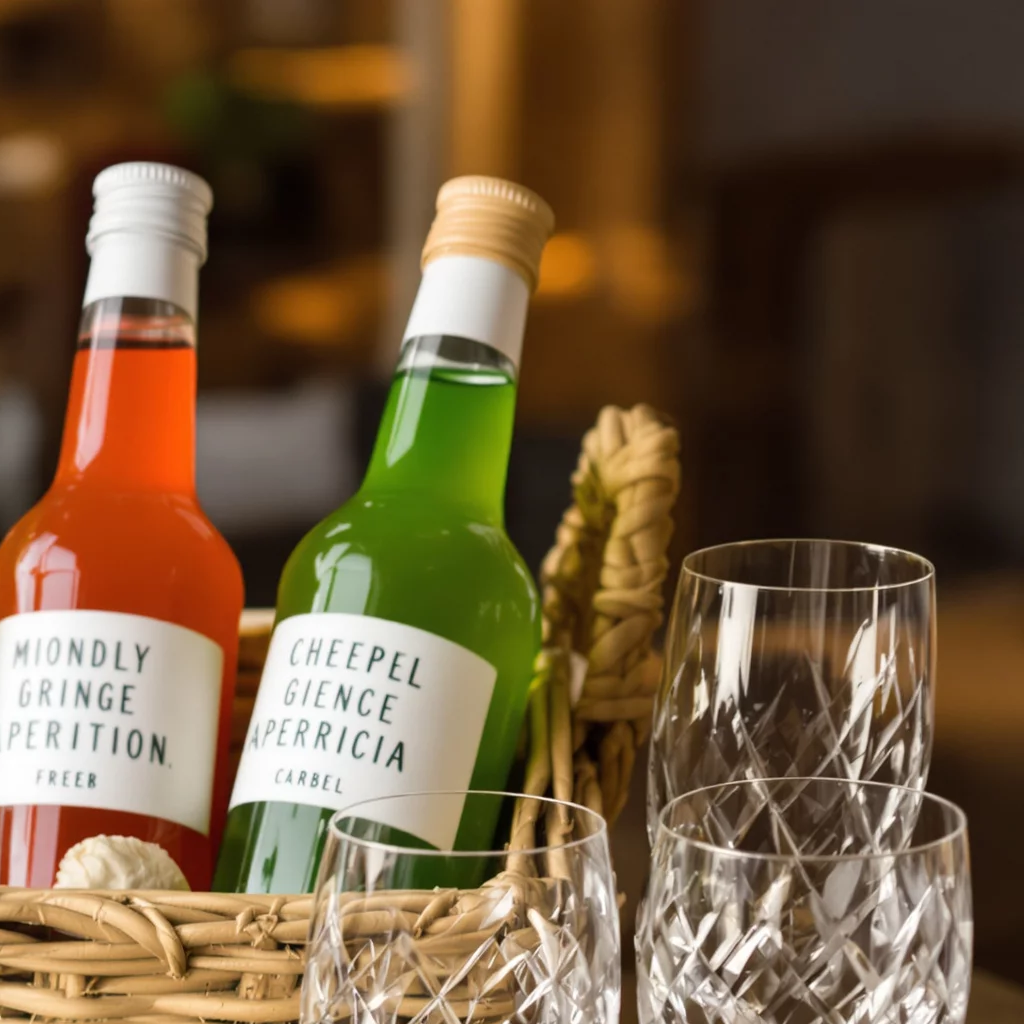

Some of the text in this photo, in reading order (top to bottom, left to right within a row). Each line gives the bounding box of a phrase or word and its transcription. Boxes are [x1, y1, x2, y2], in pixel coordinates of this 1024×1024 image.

[12, 636, 150, 674] MIONDLY
[289, 637, 422, 689] CHEEPEL
[18, 678, 136, 715] GRINGE
[284, 678, 398, 725] GIENCE
[249, 718, 406, 772] APERRICIA
[275, 768, 343, 794] CARBEL
